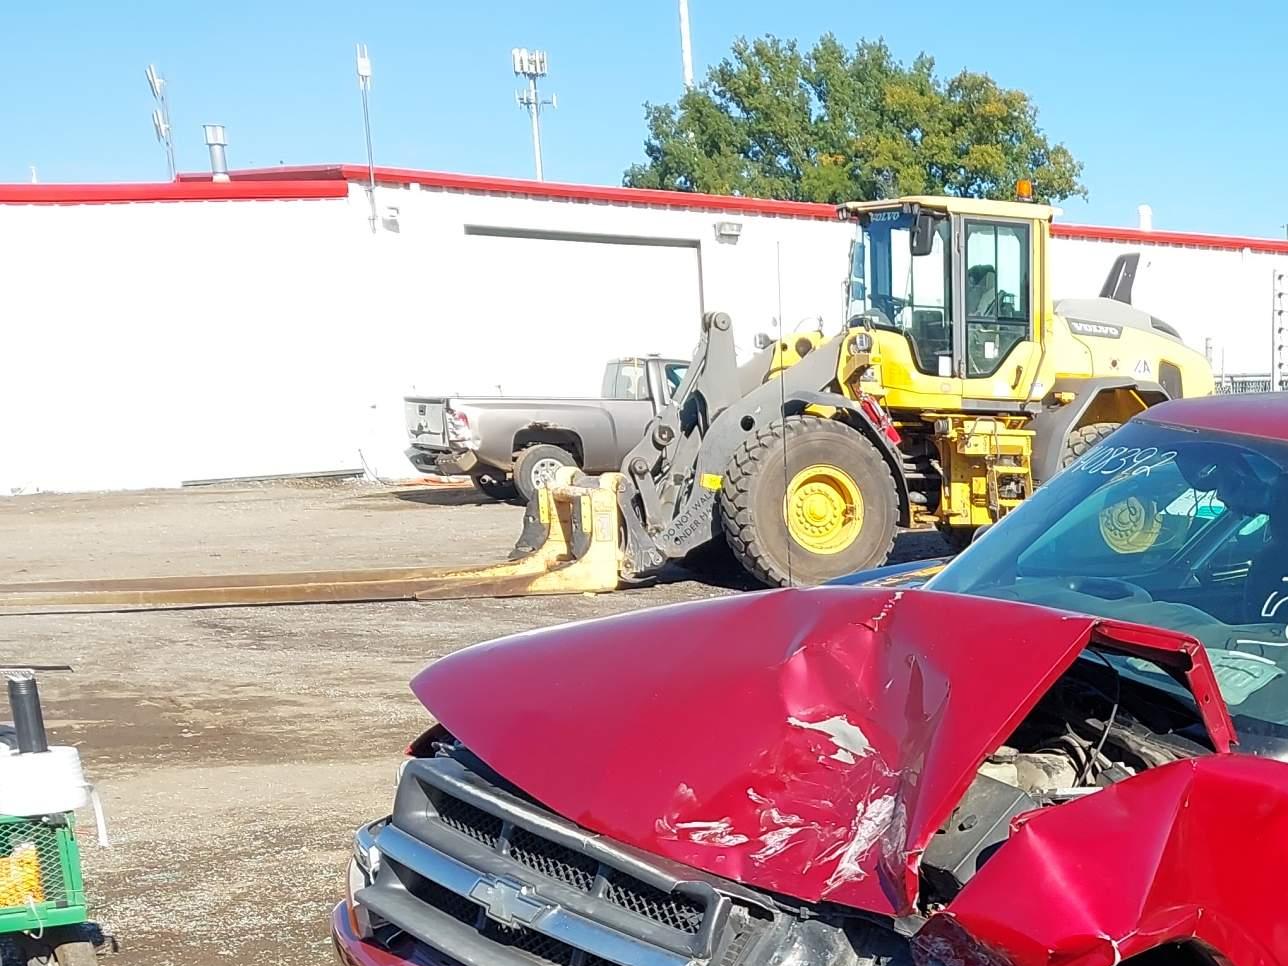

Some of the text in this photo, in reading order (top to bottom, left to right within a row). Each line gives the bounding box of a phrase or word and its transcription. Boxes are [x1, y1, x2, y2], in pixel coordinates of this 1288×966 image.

[868, 211, 900, 222] VOLVO
[1071, 322, 1119, 335] VOLVO
[674, 510, 692, 530] NOT
[673, 519, 701, 546] UNDER
